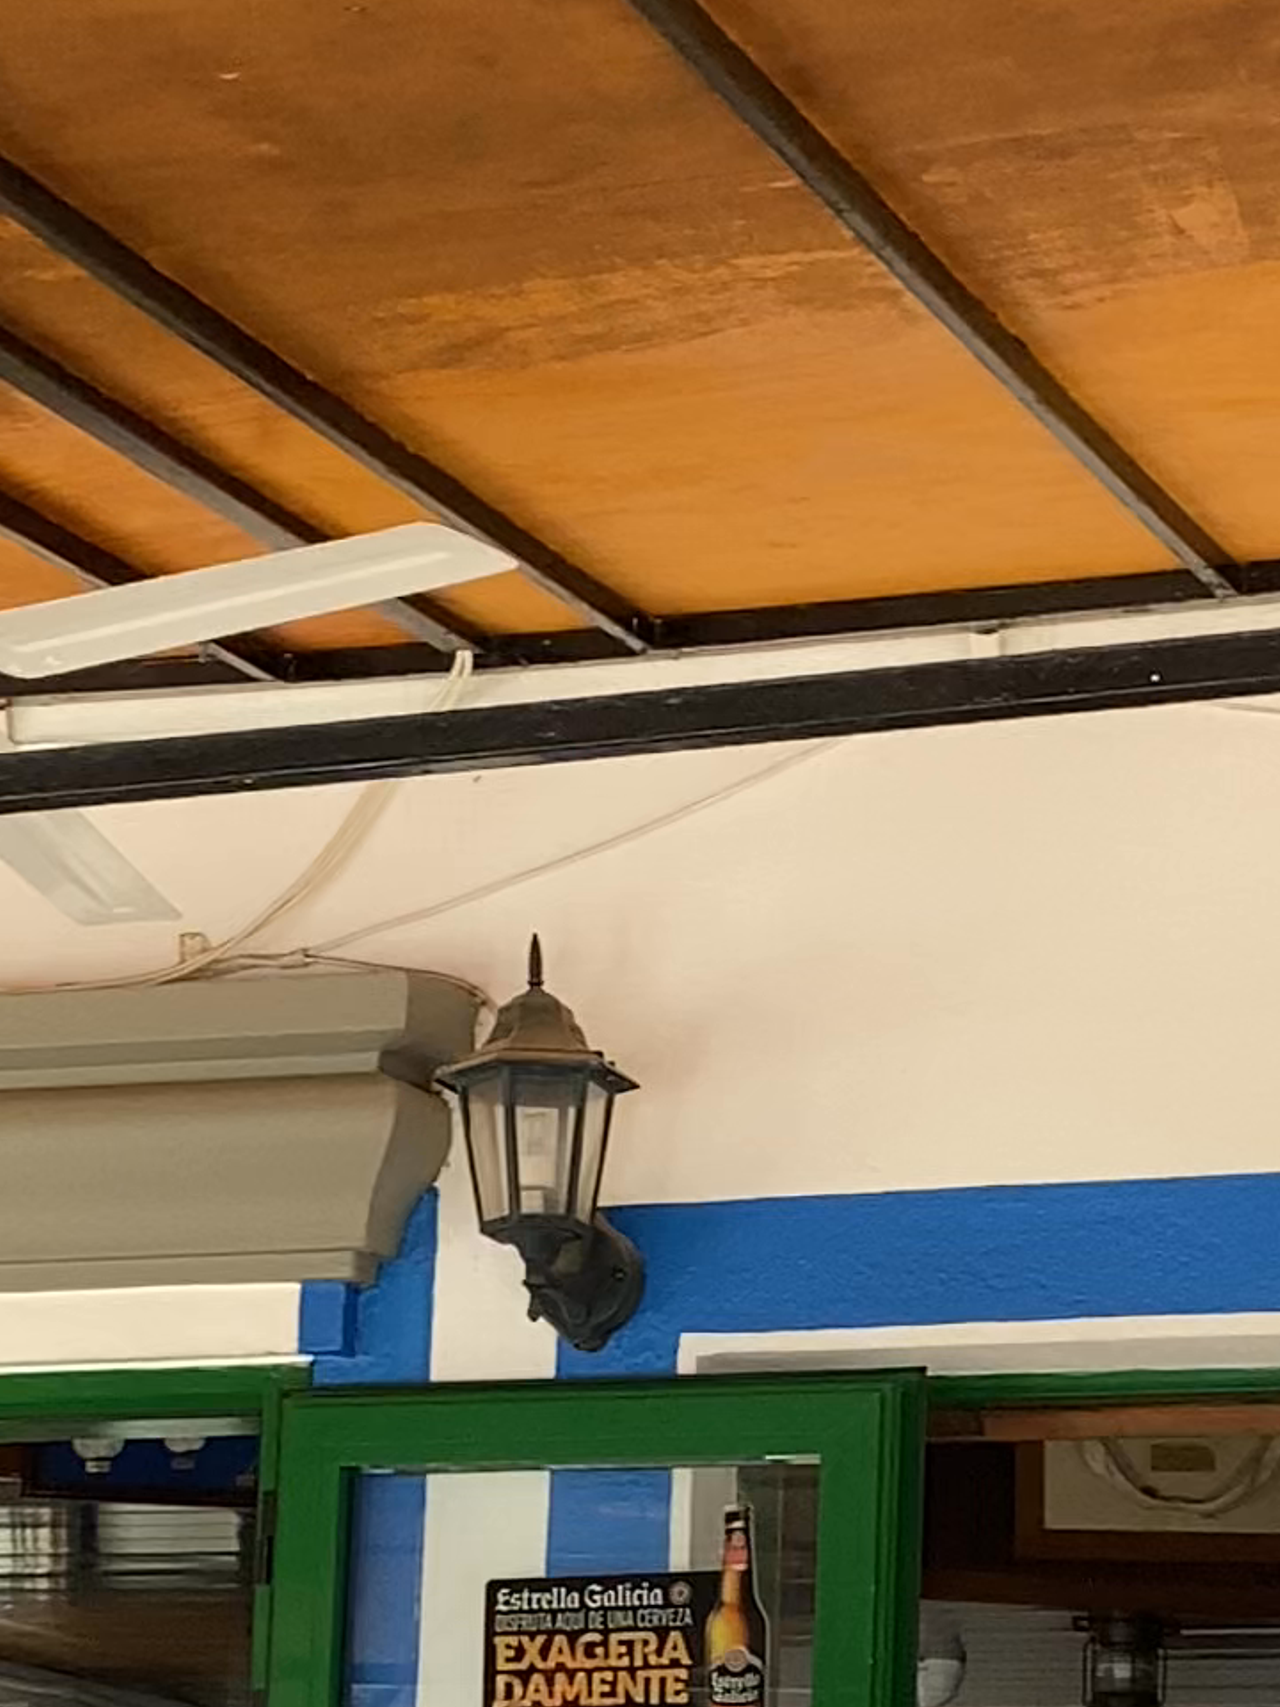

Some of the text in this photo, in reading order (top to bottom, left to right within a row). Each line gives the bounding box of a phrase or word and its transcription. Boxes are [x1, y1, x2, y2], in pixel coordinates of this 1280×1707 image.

[494, 1581, 664, 1612] Estrella Galicia
[588, 1610, 605, 1630] DE
[636, 1606, 695, 1628] CERVEZA
[493, 1630, 694, 1671] EXAGERA
